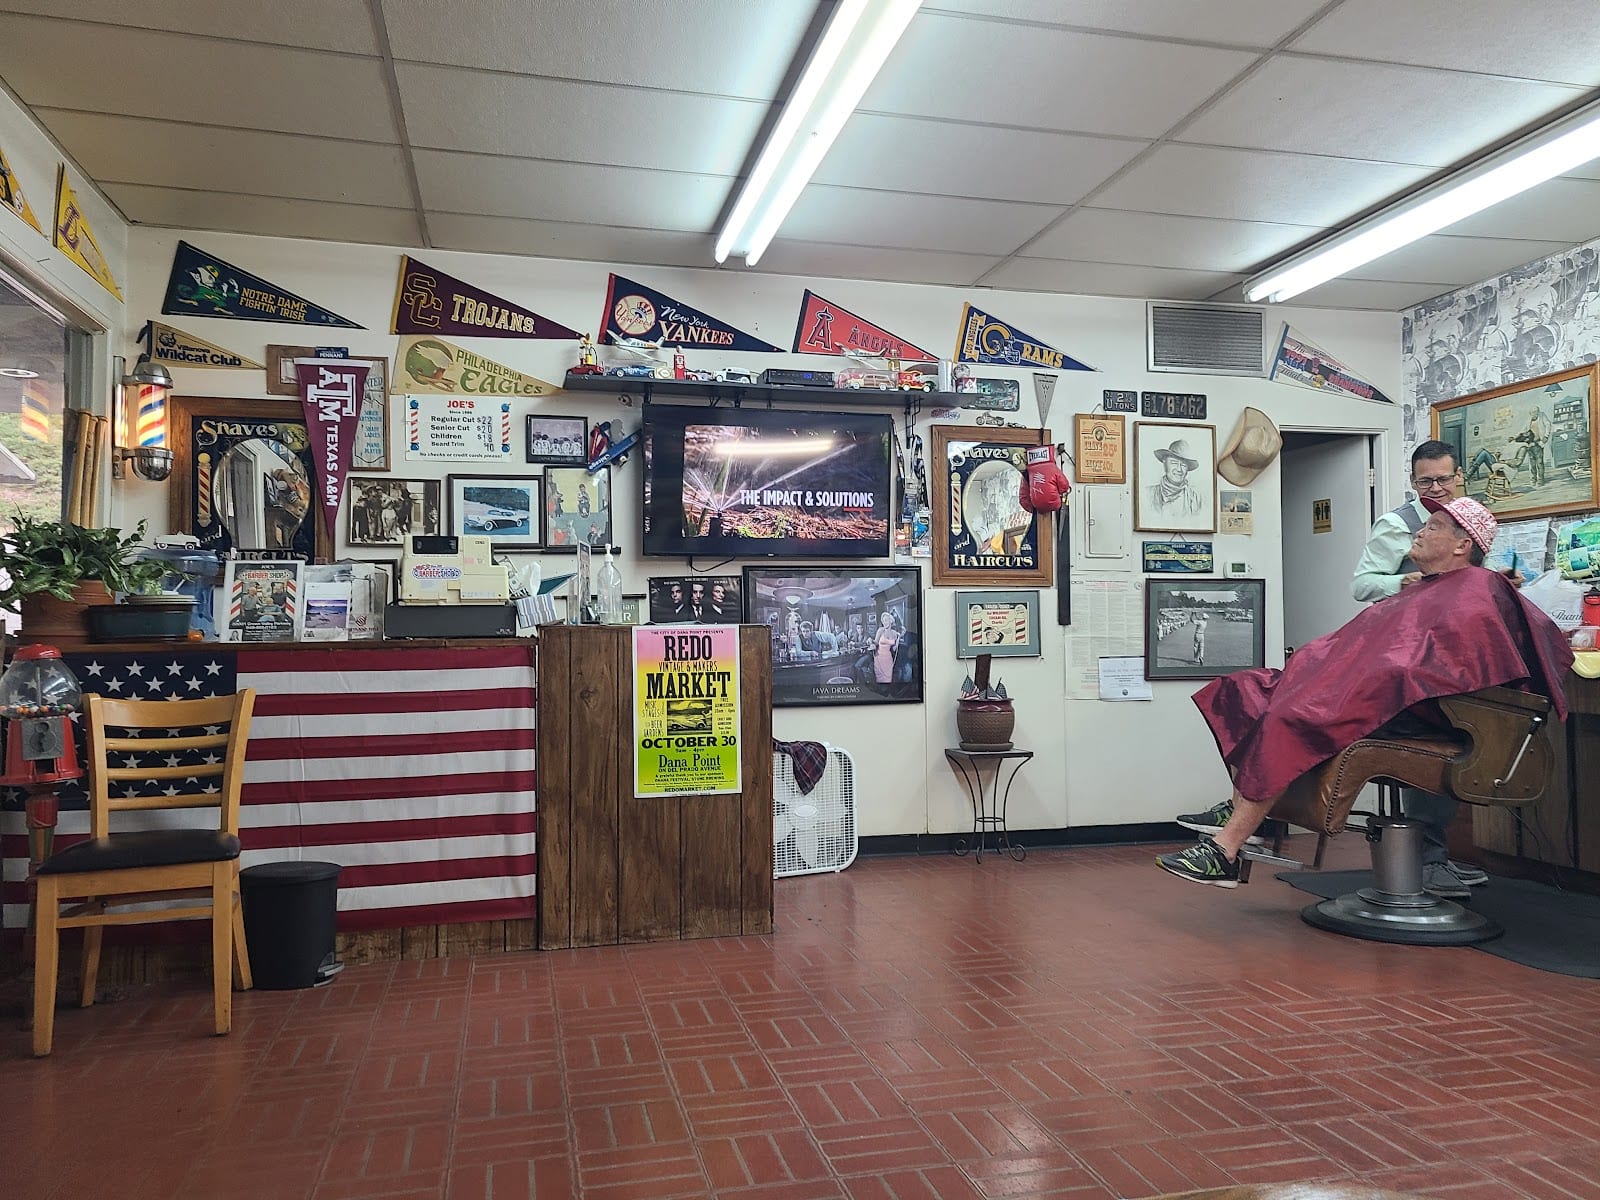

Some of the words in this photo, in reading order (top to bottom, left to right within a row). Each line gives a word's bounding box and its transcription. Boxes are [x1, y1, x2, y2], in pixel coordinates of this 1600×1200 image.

[241, 287, 275, 305] NOTRE
[277, 296, 308, 313] DAME
[280, 307, 305, 322] IRISH
[450, 294, 535, 334] TROJANS
[660, 304, 689, 323] New
[688, 315, 710, 329] York
[658, 320, 735, 345] YANKEES
[968, 318, 978, 341] ANGELES
[156, 347, 208, 363] Wildcat
[210, 354, 242, 366] Club
[965, 340, 973, 354] LOS
[1021, 343, 1064, 368] RAMS
[456, 349, 522, 381] PHILADELPHIA
[460, 367, 543, 394] EAGLES
[1328, 374, 1374, 398] CHAMPIONS
[447, 400, 475, 408] JOE'S
[1115, 402, 1135, 410] TONS
[430, 416, 460, 424] Regular
[476, 416, 492, 424] $22
[325, 424, 340, 472] TEXAS
[477, 434, 493, 443] $18
[325, 474, 339, 507] A&M
[740, 490, 760, 505] THE
[763, 490, 803, 506] IMPACT
[805, 491, 814, 506] &
[816, 492, 874, 508] SOLUTIONS
[954, 534, 970, 550] and
[954, 554, 1034, 567] HAIRCUTS
[664, 635, 712, 661] REDO
[658, 662, 683, 672] VINTAGE
[686, 662, 691, 672] &
[693, 661, 718, 672] MAKERS
[646, 672, 730, 699] MARKET
[642, 736, 717, 749] OCTOBER
[721, 736, 736, 746] 30
[659, 755, 687, 768] Dana
[693, 753, 720, 767] Point
